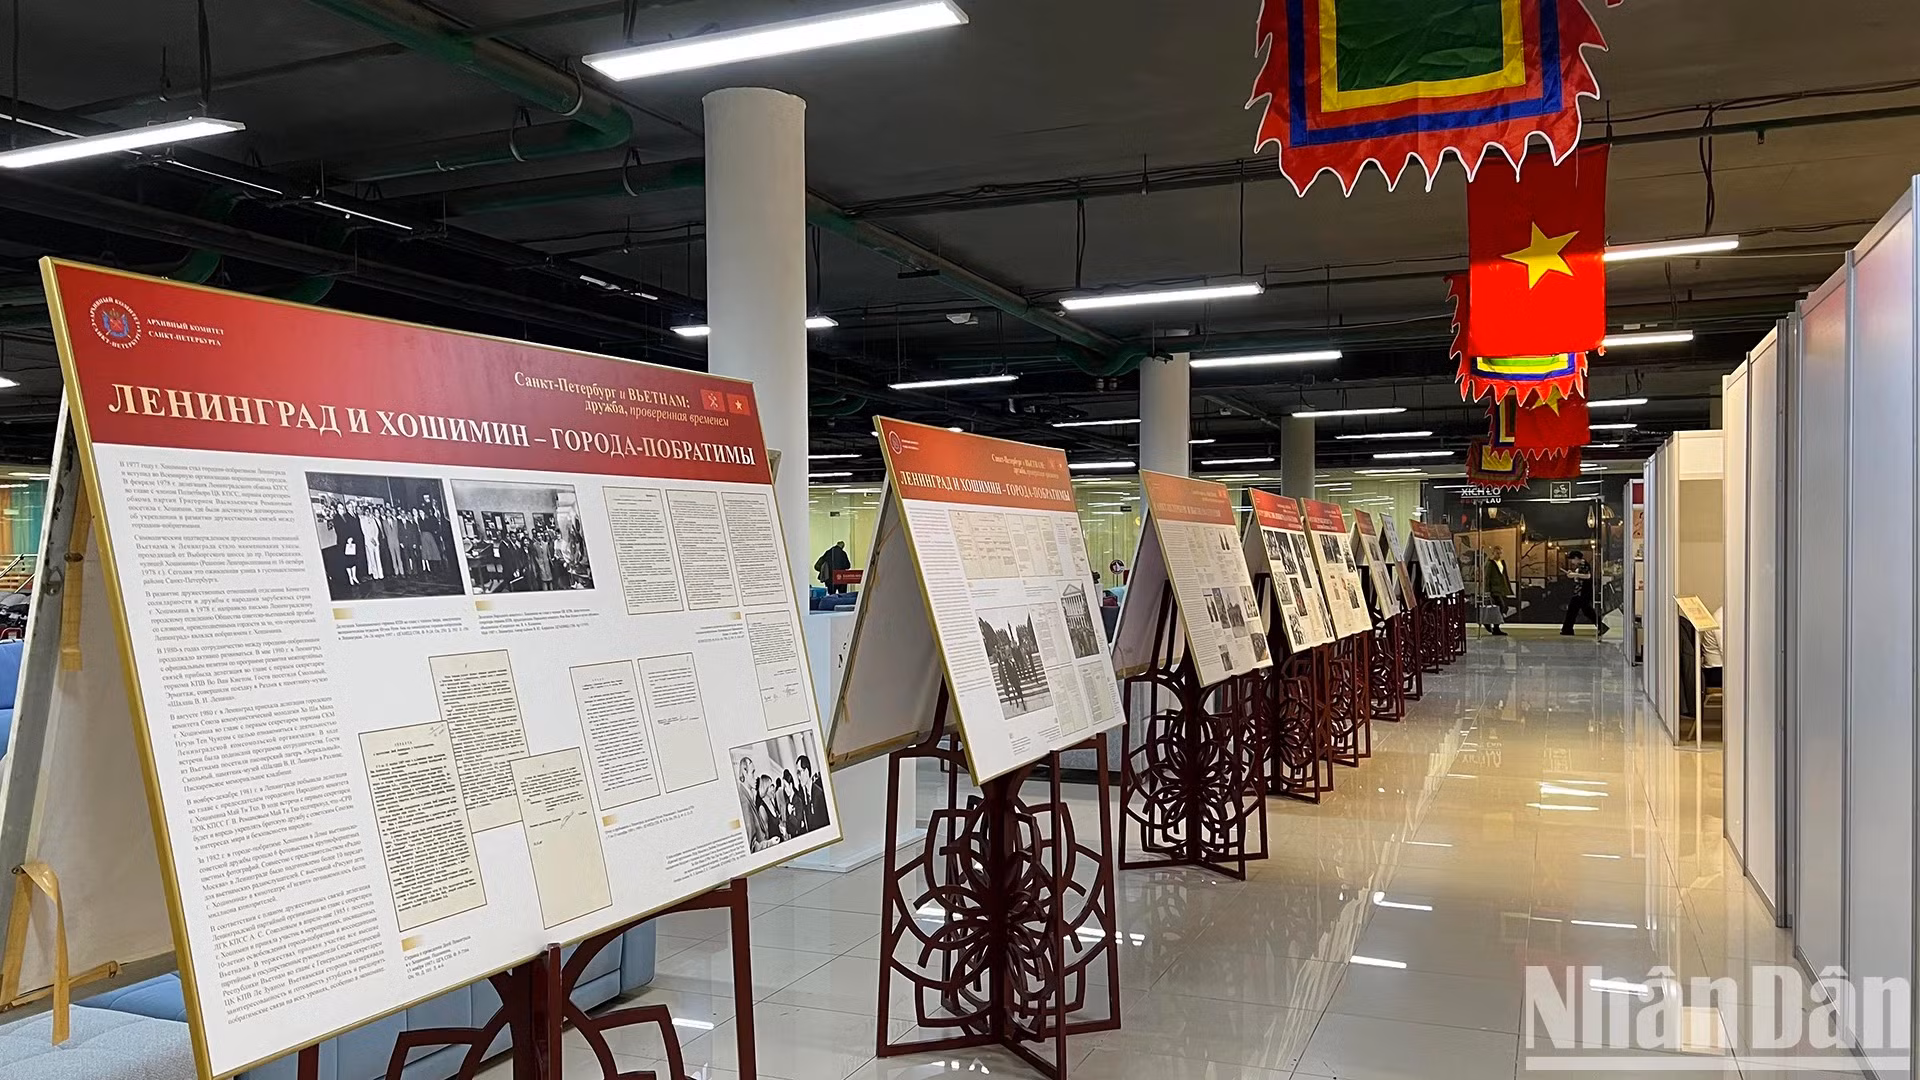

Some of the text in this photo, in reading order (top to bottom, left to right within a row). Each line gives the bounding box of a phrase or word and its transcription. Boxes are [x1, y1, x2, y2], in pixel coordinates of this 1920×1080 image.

[147, 318, 224, 336] АРХИВНЫЙ КОМИТЕТ
[148, 330, 222, 346] САНКТ-ПЕТЕРБУРГА
[514, 371, 691, 409] Санкт-Петербург и ВЬЕТНАМ:
[108, 383, 342, 438] ЛЕНИНГРАД
[347, 407, 372, 434] И
[375, 410, 531, 448] ХОШИМИН
[550, 428, 757, 466] ГОРОДА-ПОБРАТИМЫ
[585, 400, 729, 427] дружба, проверенная временем
[900, 470, 953, 491] ЛЕНИНГРАД
[960, 478, 1001, 496] ХОШИМИН
[1006, 483, 1070, 501] ГОРОДА-ПОБРАТИМЫ
